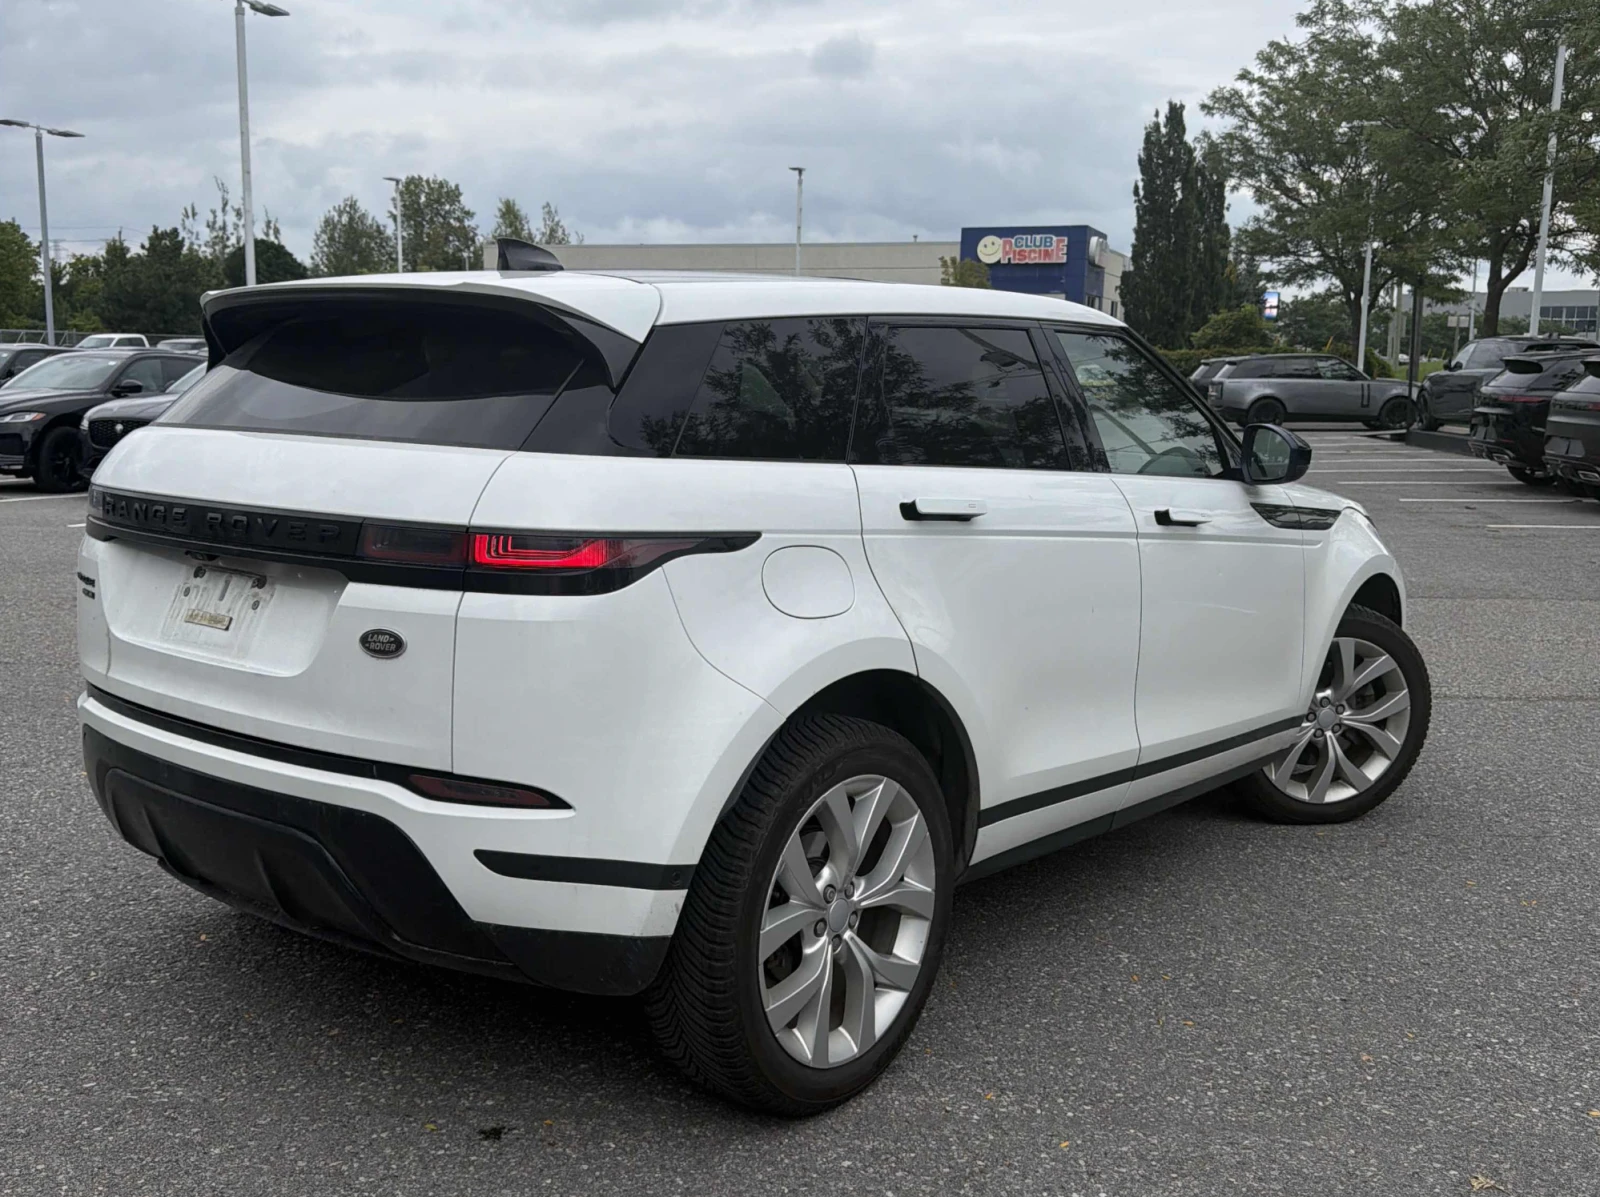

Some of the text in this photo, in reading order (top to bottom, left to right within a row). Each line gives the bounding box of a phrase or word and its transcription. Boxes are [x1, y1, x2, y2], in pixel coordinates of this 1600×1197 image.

[1001, 238, 1067, 262] PISCINE
[1014, 236, 1053, 248] CLUB
[103, 495, 341, 544] RANGE ROVER
